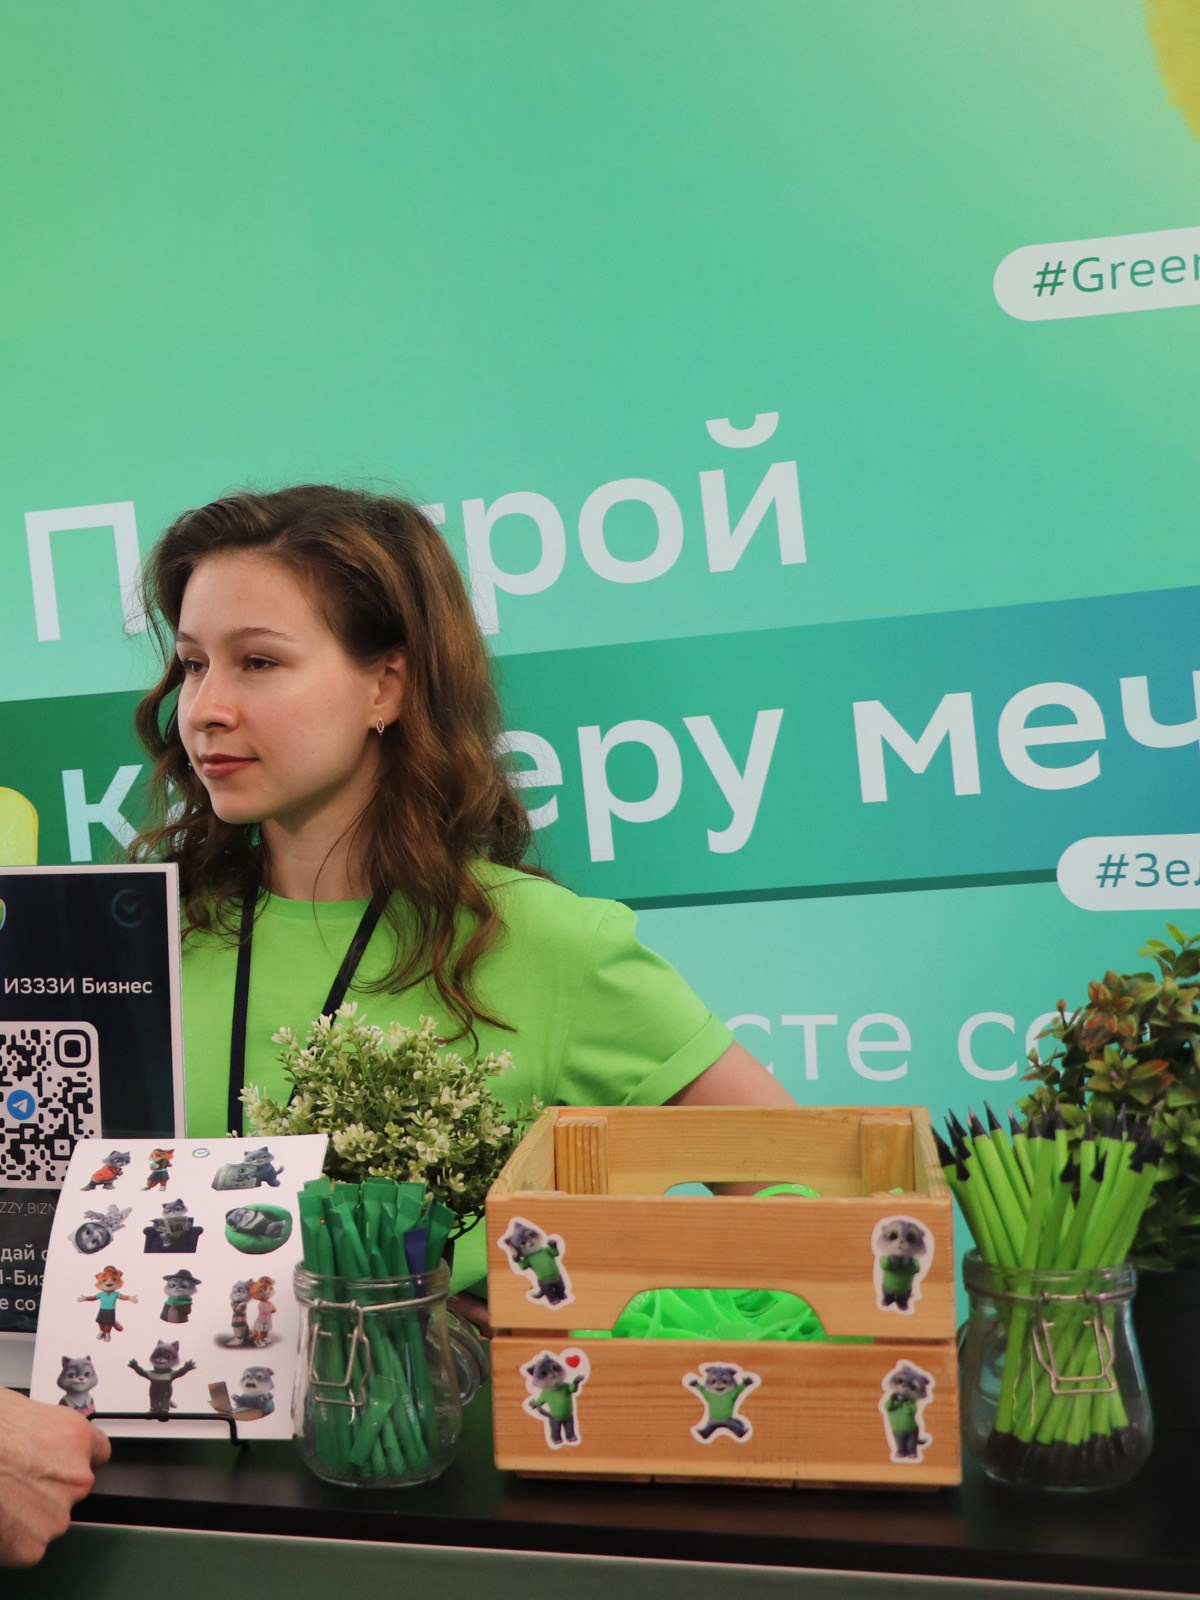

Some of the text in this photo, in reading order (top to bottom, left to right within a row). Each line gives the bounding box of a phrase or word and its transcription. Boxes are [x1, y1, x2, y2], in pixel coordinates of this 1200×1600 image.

[1033, 255, 1200, 297] #Gree
[1096, 853, 1200, 889] #Зе
[4, 976, 76, 995] ИЗЗЗИ
[82, 976, 153, 995] Бизнес
[15, 1299, 36, 1311] со
